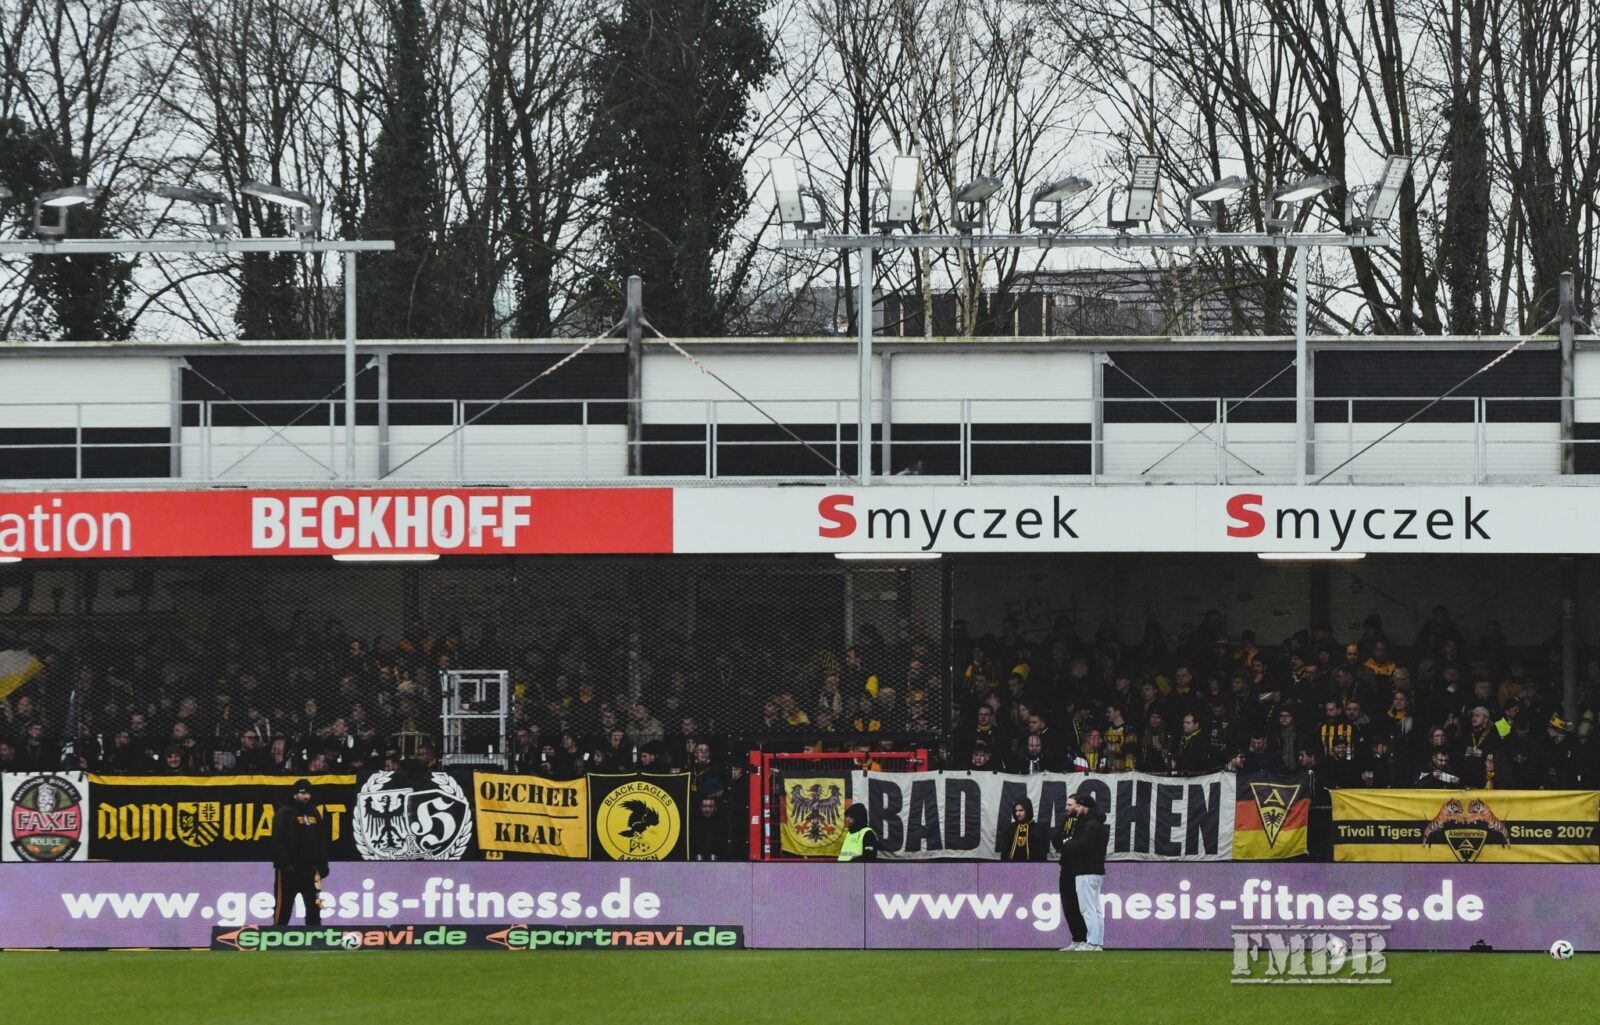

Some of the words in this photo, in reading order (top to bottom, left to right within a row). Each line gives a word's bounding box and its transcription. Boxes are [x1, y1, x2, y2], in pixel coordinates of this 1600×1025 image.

[0, 498, 131, 552] ation
[252, 495, 532, 549] BECKHOFF
[818, 494, 1080, 550] Smyczek
[1226, 494, 1492, 550] Smyczek
[480, 780, 579, 808] OECHER
[604, 783, 635, 807] BLACK
[637, 782, 673, 807] EAGLES
[16, 811, 78, 832] FAXE
[868, 777, 983, 852] BAD
[30, 837, 62, 846] POLICE
[494, 822, 563, 847] KRAU
[1338, 825, 1375, 837] Tivoli
[1378, 825, 1422, 840] Tigers
[1510, 825, 1553, 838] Since
[1557, 826, 1594, 838] 2007
[874, 878, 1484, 932] www.gnesis-fitness.de
[507, 926, 737, 949] sportnavi.de
